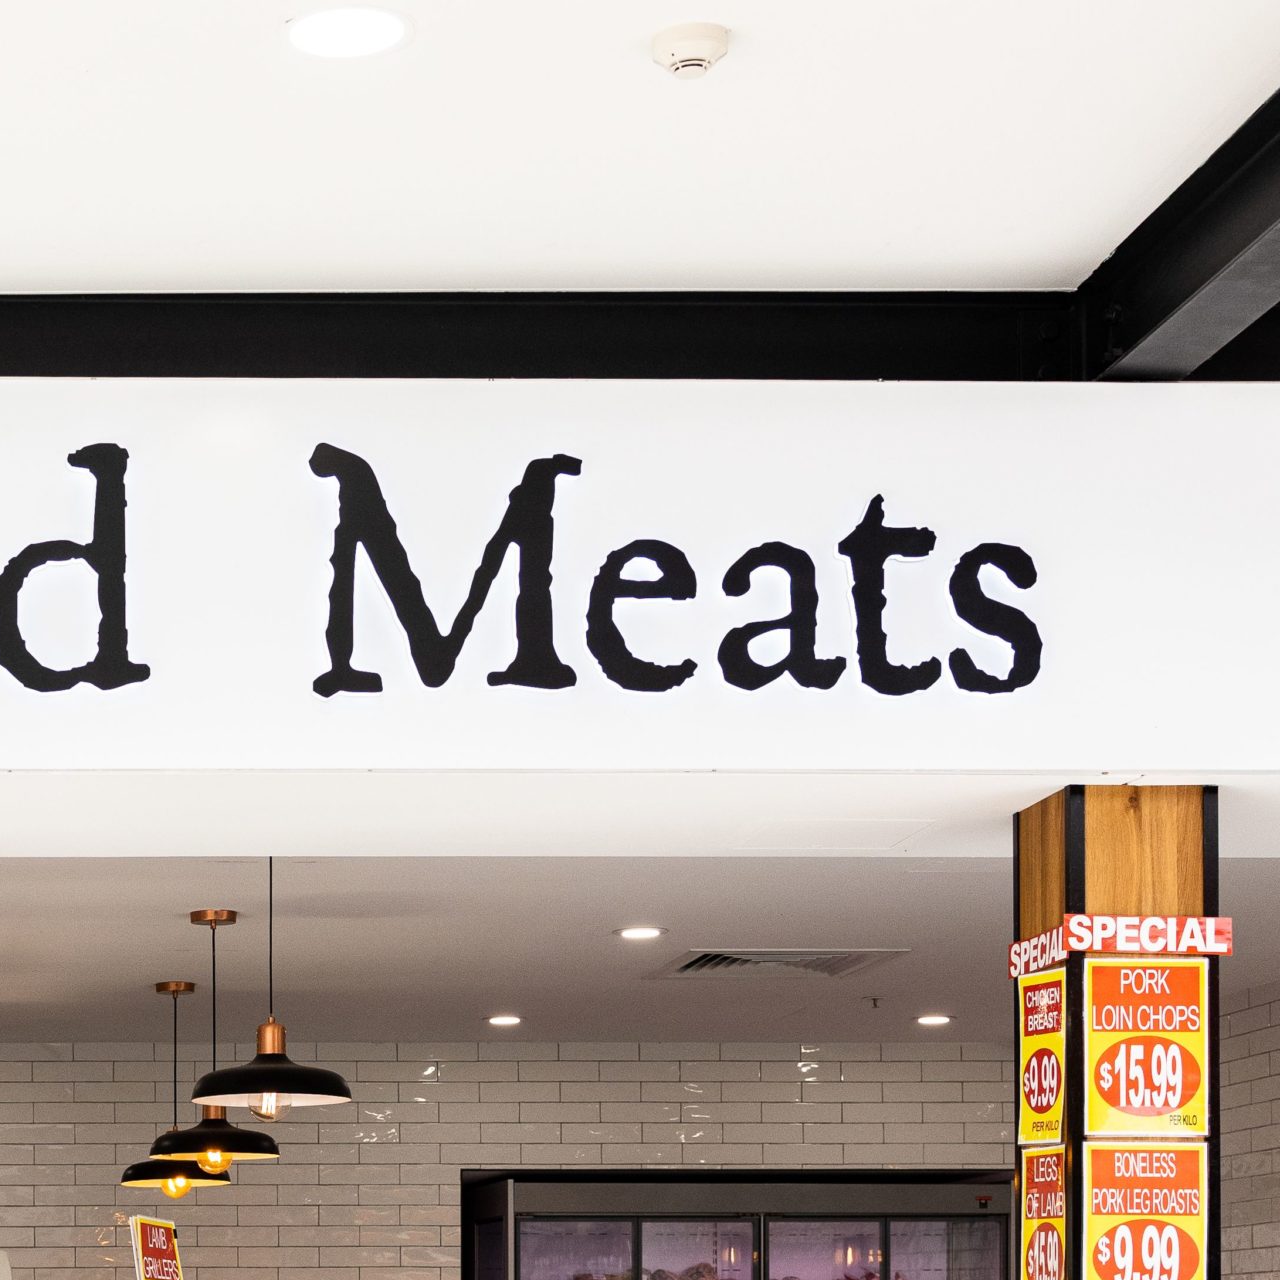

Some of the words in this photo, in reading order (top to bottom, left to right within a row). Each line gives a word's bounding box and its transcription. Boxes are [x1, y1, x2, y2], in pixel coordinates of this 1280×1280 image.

[309, 442, 1043, 696] Meats
[1067, 915, 1228, 952] SPECIAL
[1009, 927, 1068, 978] SPECIAL
[1120, 968, 1170, 994] PORK
[1026, 986, 1060, 1008] CHICKEN
[1027, 1013, 1059, 1032] BREAST
[1092, 1006, 1132, 1030] LOIN
[1137, 1005, 1200, 1031] CHOPS
[1024, 1054, 1058, 1108] $9.99
[1099, 1043, 1182, 1109] $15.99
[1032, 1121, 1045, 1132] PER
[1045, 1119, 1060, 1131] KILO
[1169, 1115, 1181, 1126] PER
[1183, 1115, 1197, 1126] KILO
[1034, 1156, 1058, 1182] LEGS
[1114, 1153, 1176, 1178] BONELESS
[1026, 1193, 1039, 1218] OF
[1041, 1191, 1064, 1217] LAMB
[1092, 1188, 1124, 1214] PORK
[1126, 1188, 1150, 1214] LEG
[1153, 1188, 1200, 1214] ROASTS
[147, 1226, 167, 1249] LAMB
